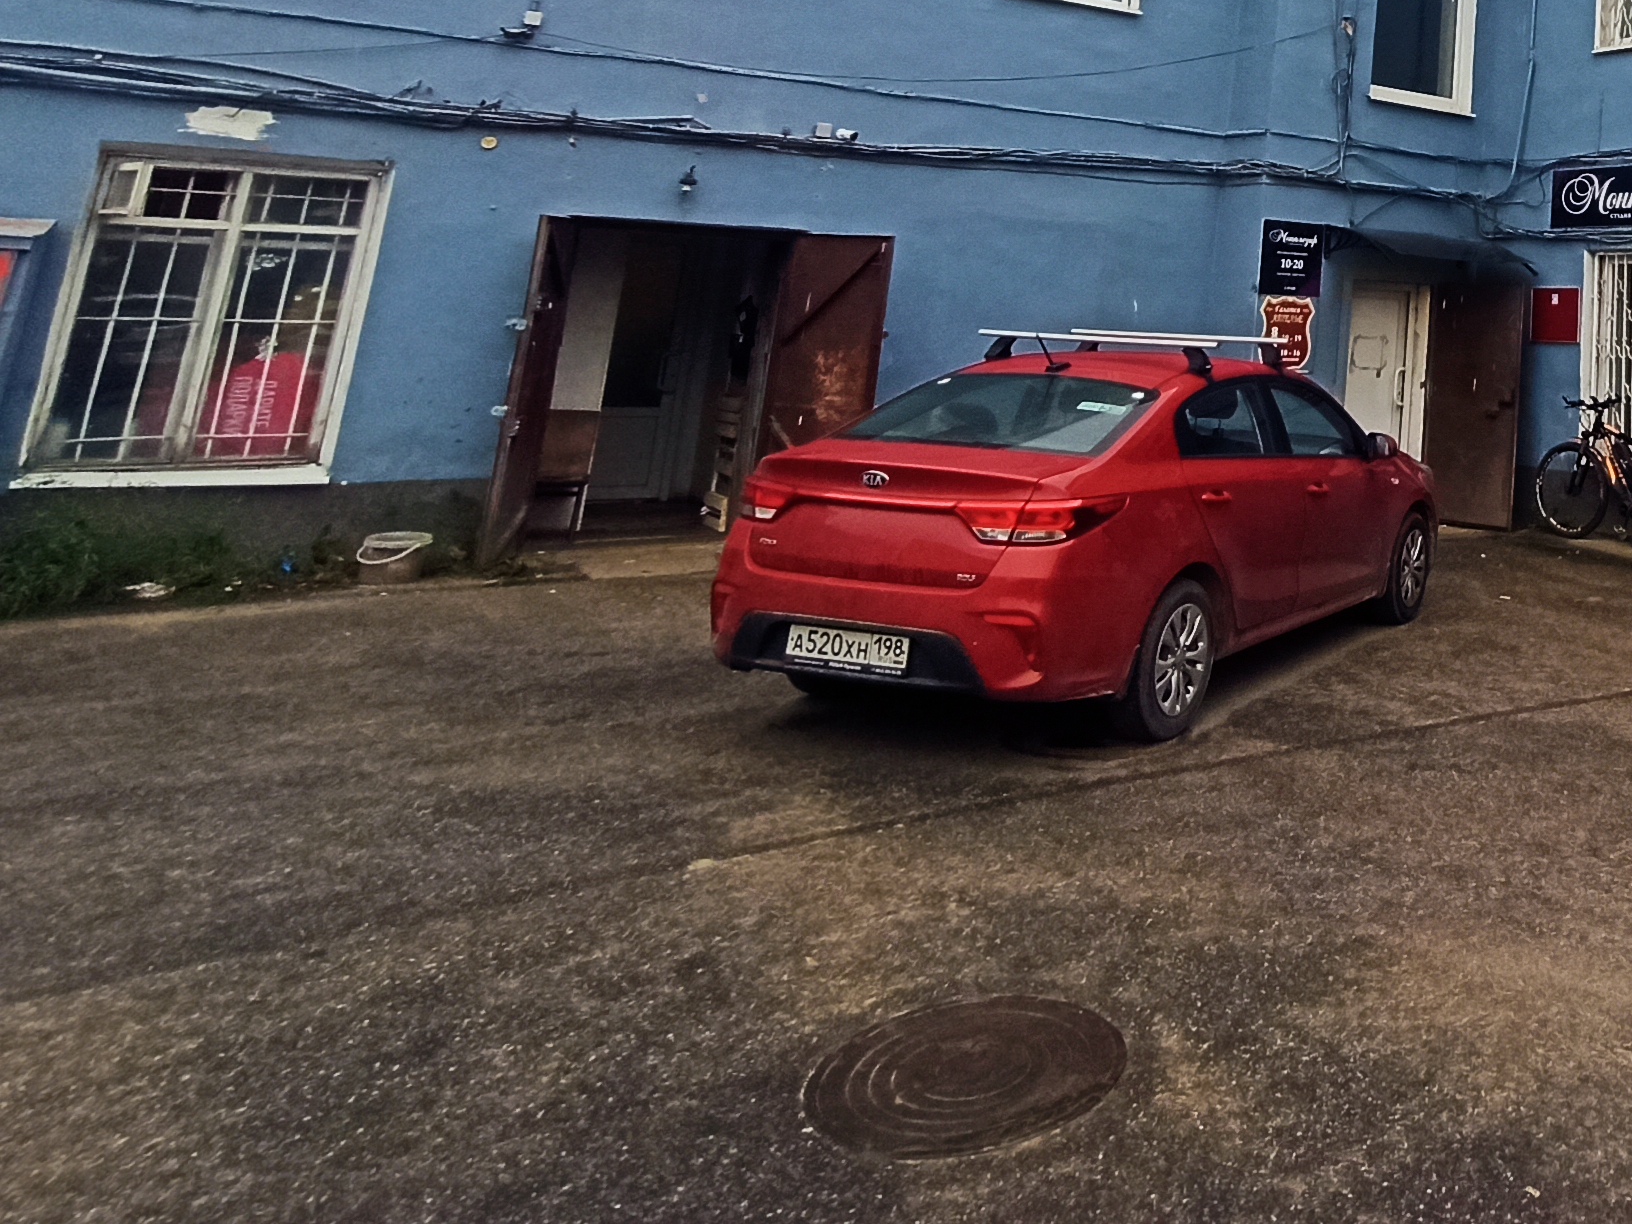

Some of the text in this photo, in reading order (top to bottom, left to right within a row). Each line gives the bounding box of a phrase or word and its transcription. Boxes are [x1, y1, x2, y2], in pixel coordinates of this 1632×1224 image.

[1281, 258, 1304, 269] 10-20
[863, 474, 882, 485] KIA
[874, 636, 904, 657] 198
